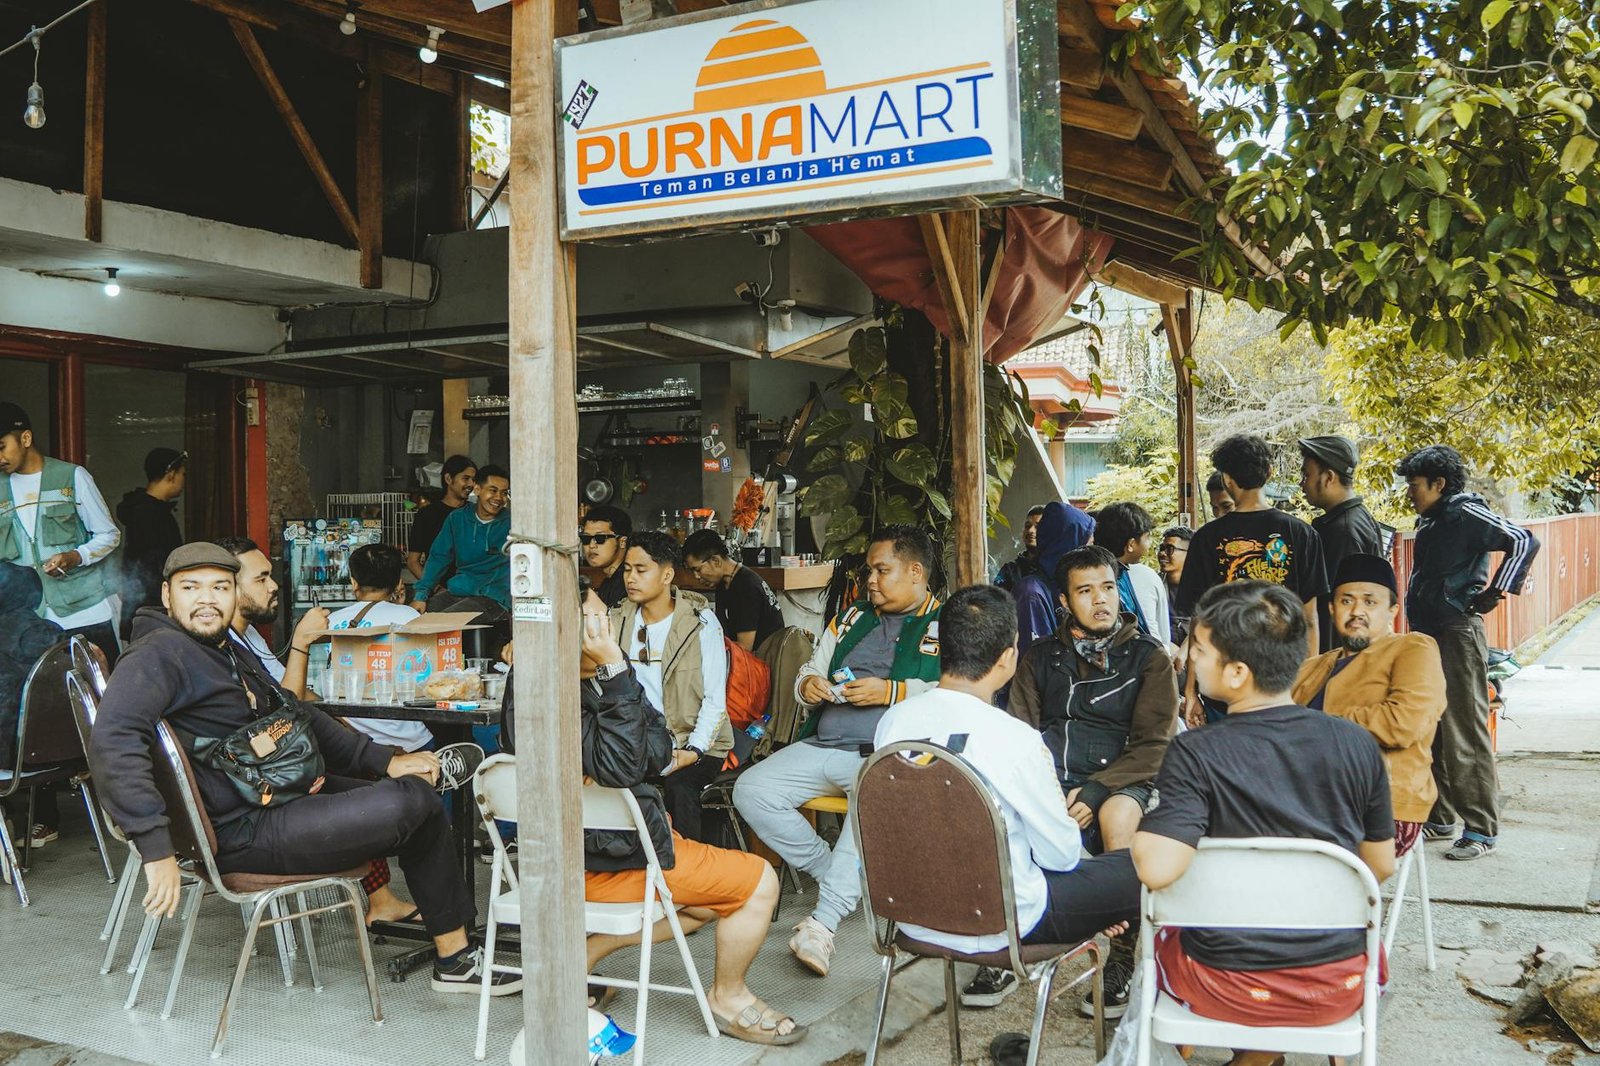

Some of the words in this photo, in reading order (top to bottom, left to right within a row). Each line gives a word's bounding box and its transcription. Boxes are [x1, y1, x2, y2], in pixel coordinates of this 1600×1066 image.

[639, 177, 712, 197] Teman
[724, 162, 819, 187] Belanja
[831, 148, 915, 172] Hemat
[442, 648, 457, 662] 48
[371, 658, 387, 670] 48
